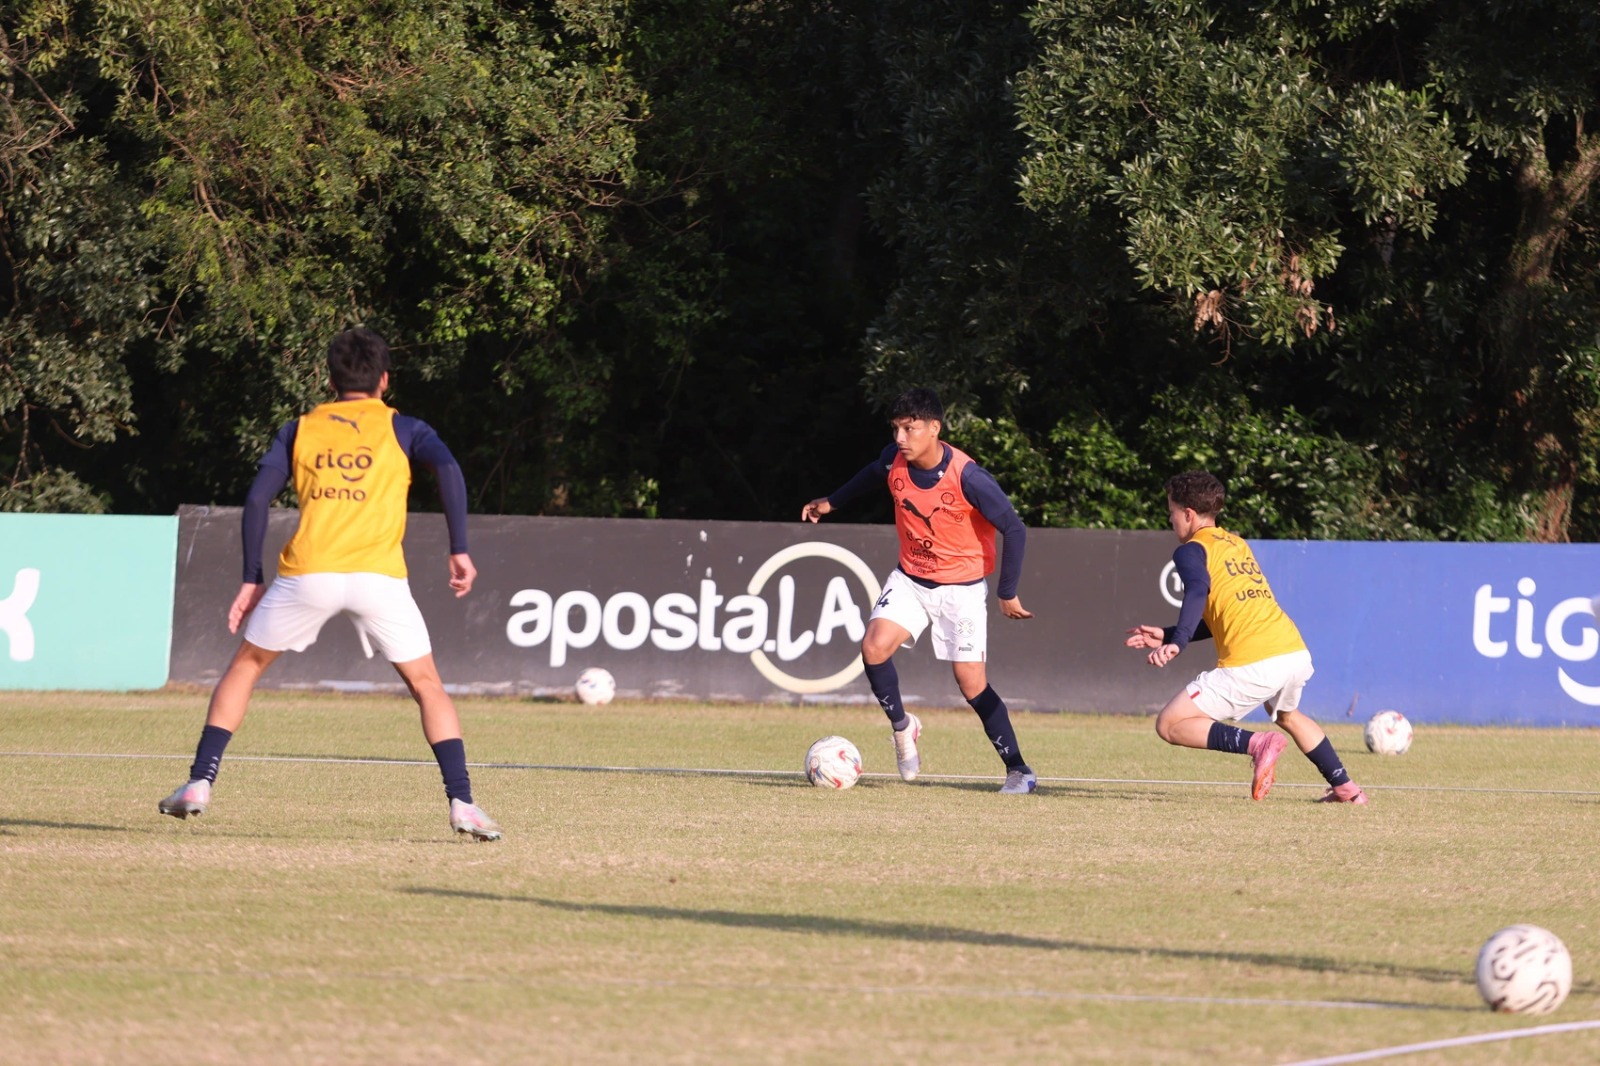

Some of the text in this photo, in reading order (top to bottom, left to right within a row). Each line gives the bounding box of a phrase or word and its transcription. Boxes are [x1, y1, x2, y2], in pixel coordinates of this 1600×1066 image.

[315, 446, 373, 482] tigo
[311, 487, 366, 501] ueno
[1224, 557, 1262, 584] tigo
[1236, 589, 1272, 601] ueno
